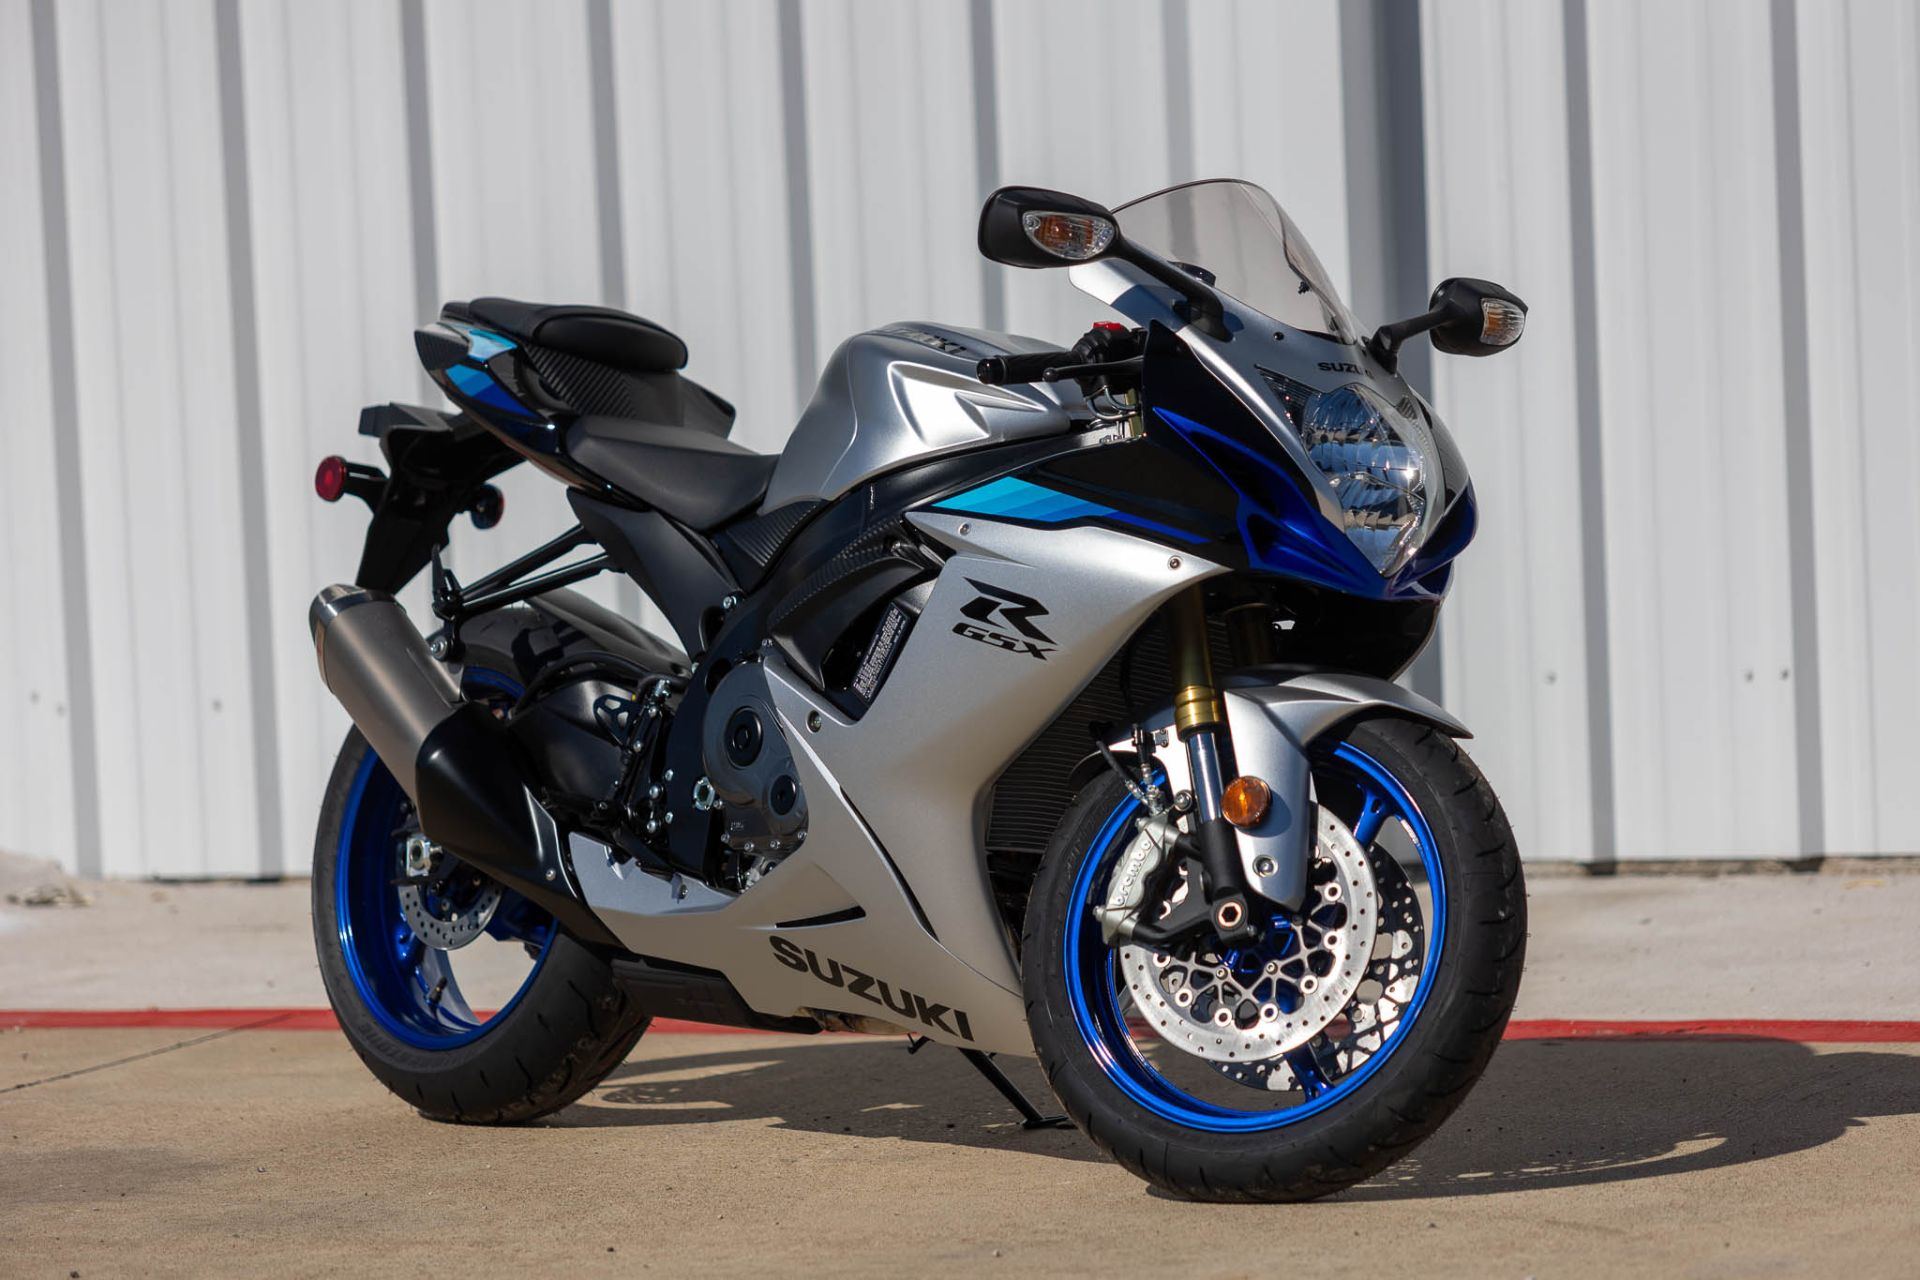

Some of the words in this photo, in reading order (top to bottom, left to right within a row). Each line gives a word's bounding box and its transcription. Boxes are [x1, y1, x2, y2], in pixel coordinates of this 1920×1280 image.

[952, 622, 1058, 661] GSX
[1111, 840, 1151, 906] brembo
[769, 935, 975, 1042] SUZUKI
